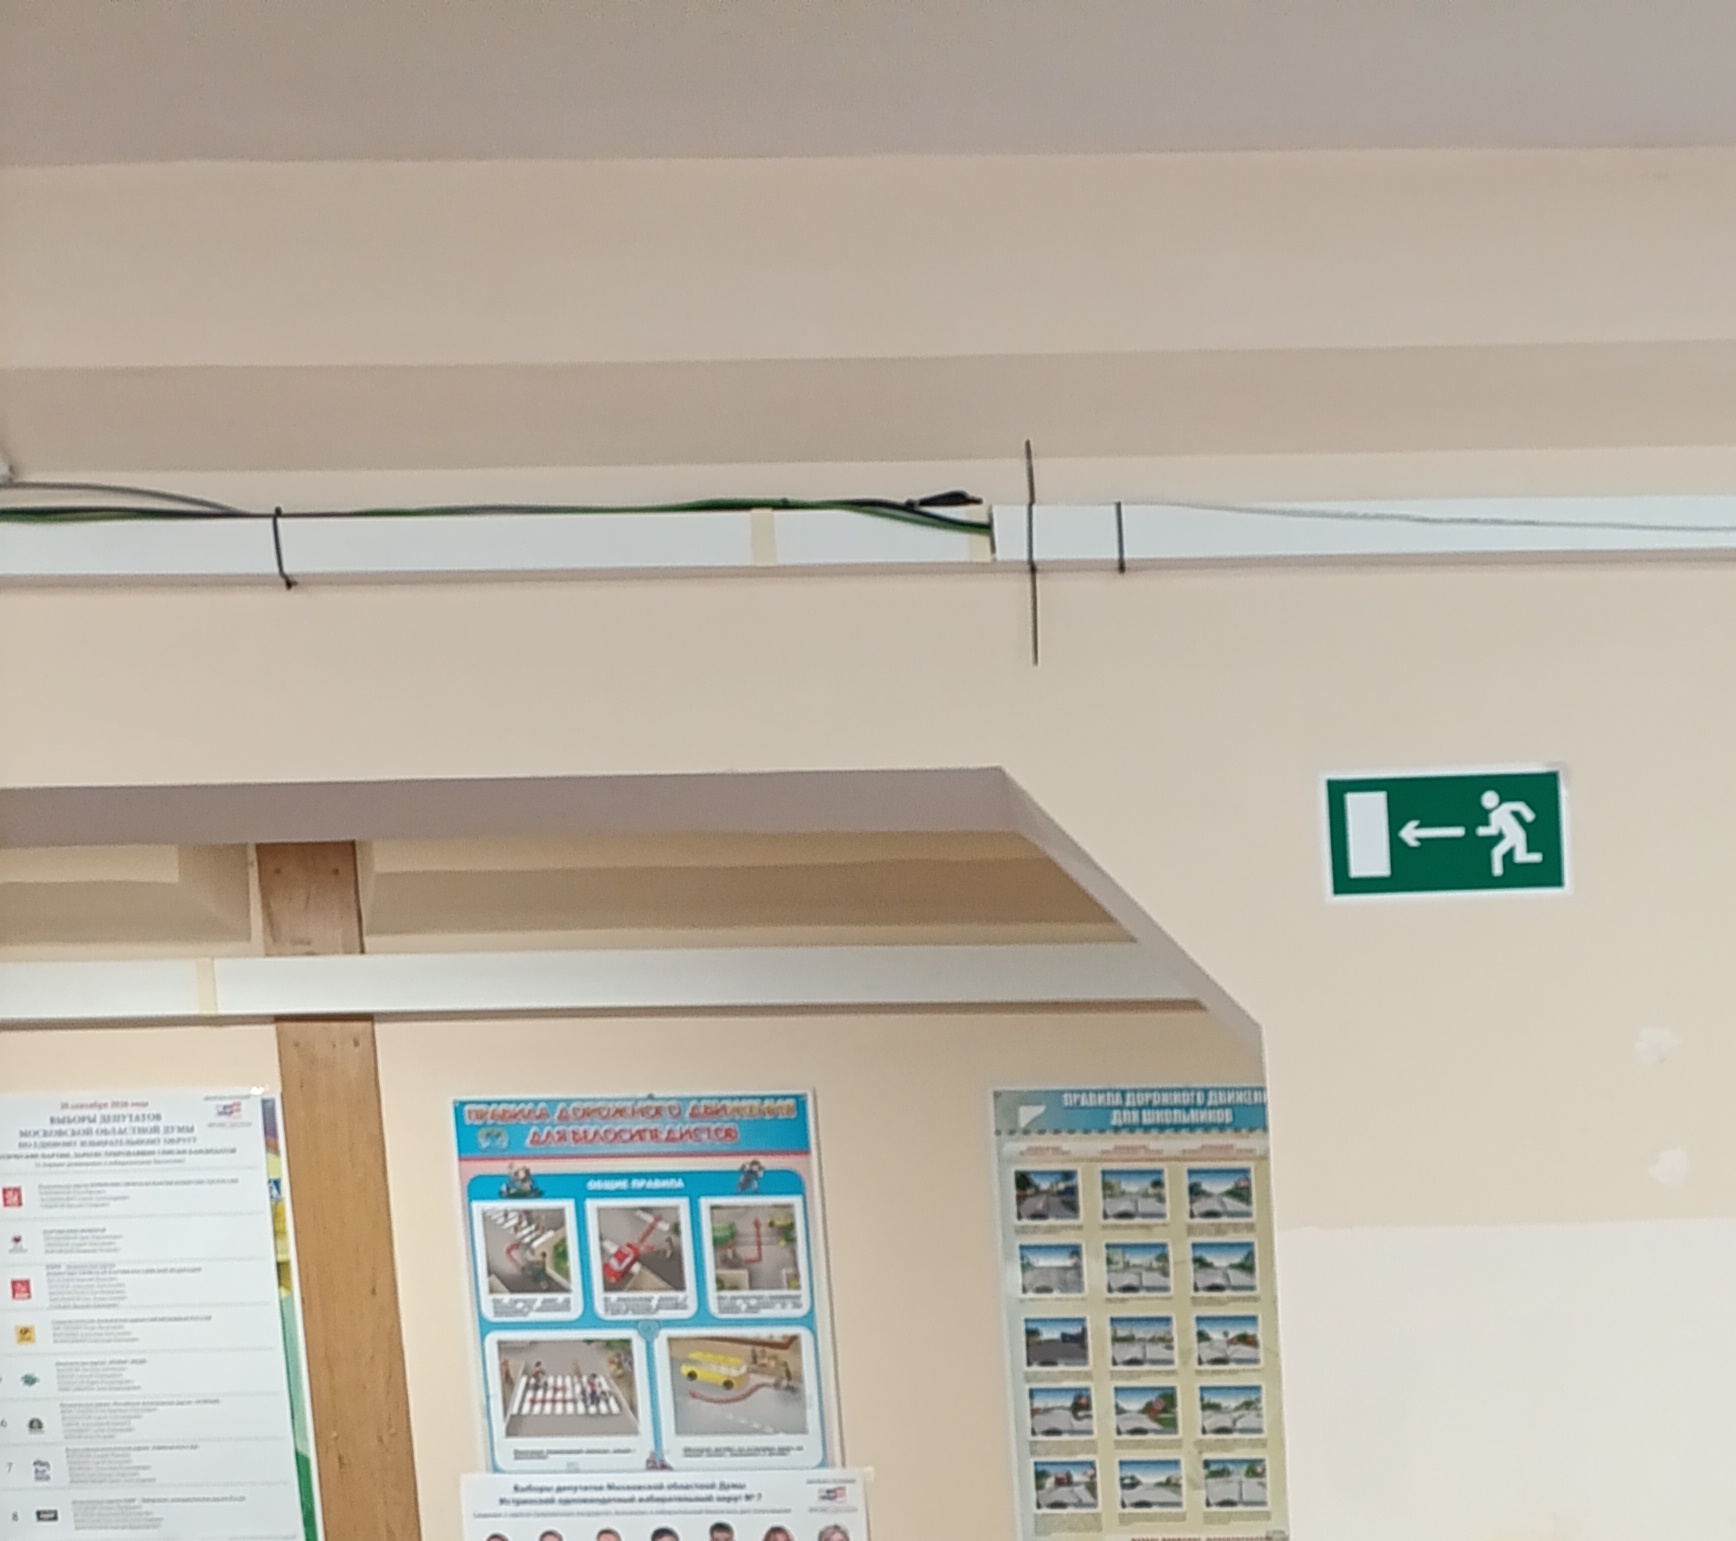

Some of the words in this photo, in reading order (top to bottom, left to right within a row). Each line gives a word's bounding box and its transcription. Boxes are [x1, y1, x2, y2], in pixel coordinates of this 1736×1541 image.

[1063, 1092, 1122, 1106] ПРАВИЛА
[1125, 1091, 1204, 1106] ДОРОЖНОГО
[49, 1115, 97, 1125] ВЫБОРЫ
[99, 1113, 162, 1124] ДЕПУТАТОВ
[466, 1104, 549, 1123] ПРАВИЛА
[555, 1102, 682, 1121] ДОРОЖНОГО
[688, 1100, 797, 1119] ДВИЖЕНИЯ
[1111, 1109, 1139, 1125] ДЛЯ
[1142, 1108, 1233, 1125] ШКОЛЬНИКОВ
[19, 1127, 93, 1138] МОСКОВСКОЙ
[95, 1125, 160, 1137] ОБЛАСТНОЙ
[163, 1125, 195, 1136] ДУМЫ
[528, 1128, 568, 1146] ДЛЯ
[571, 1124, 739, 1145] ВЕЛОСИПЕДИСТОВ
[587, 1179, 627, 1191] ОБЩИЕ
[631, 1177, 684, 1190] ПРАВИЛА
